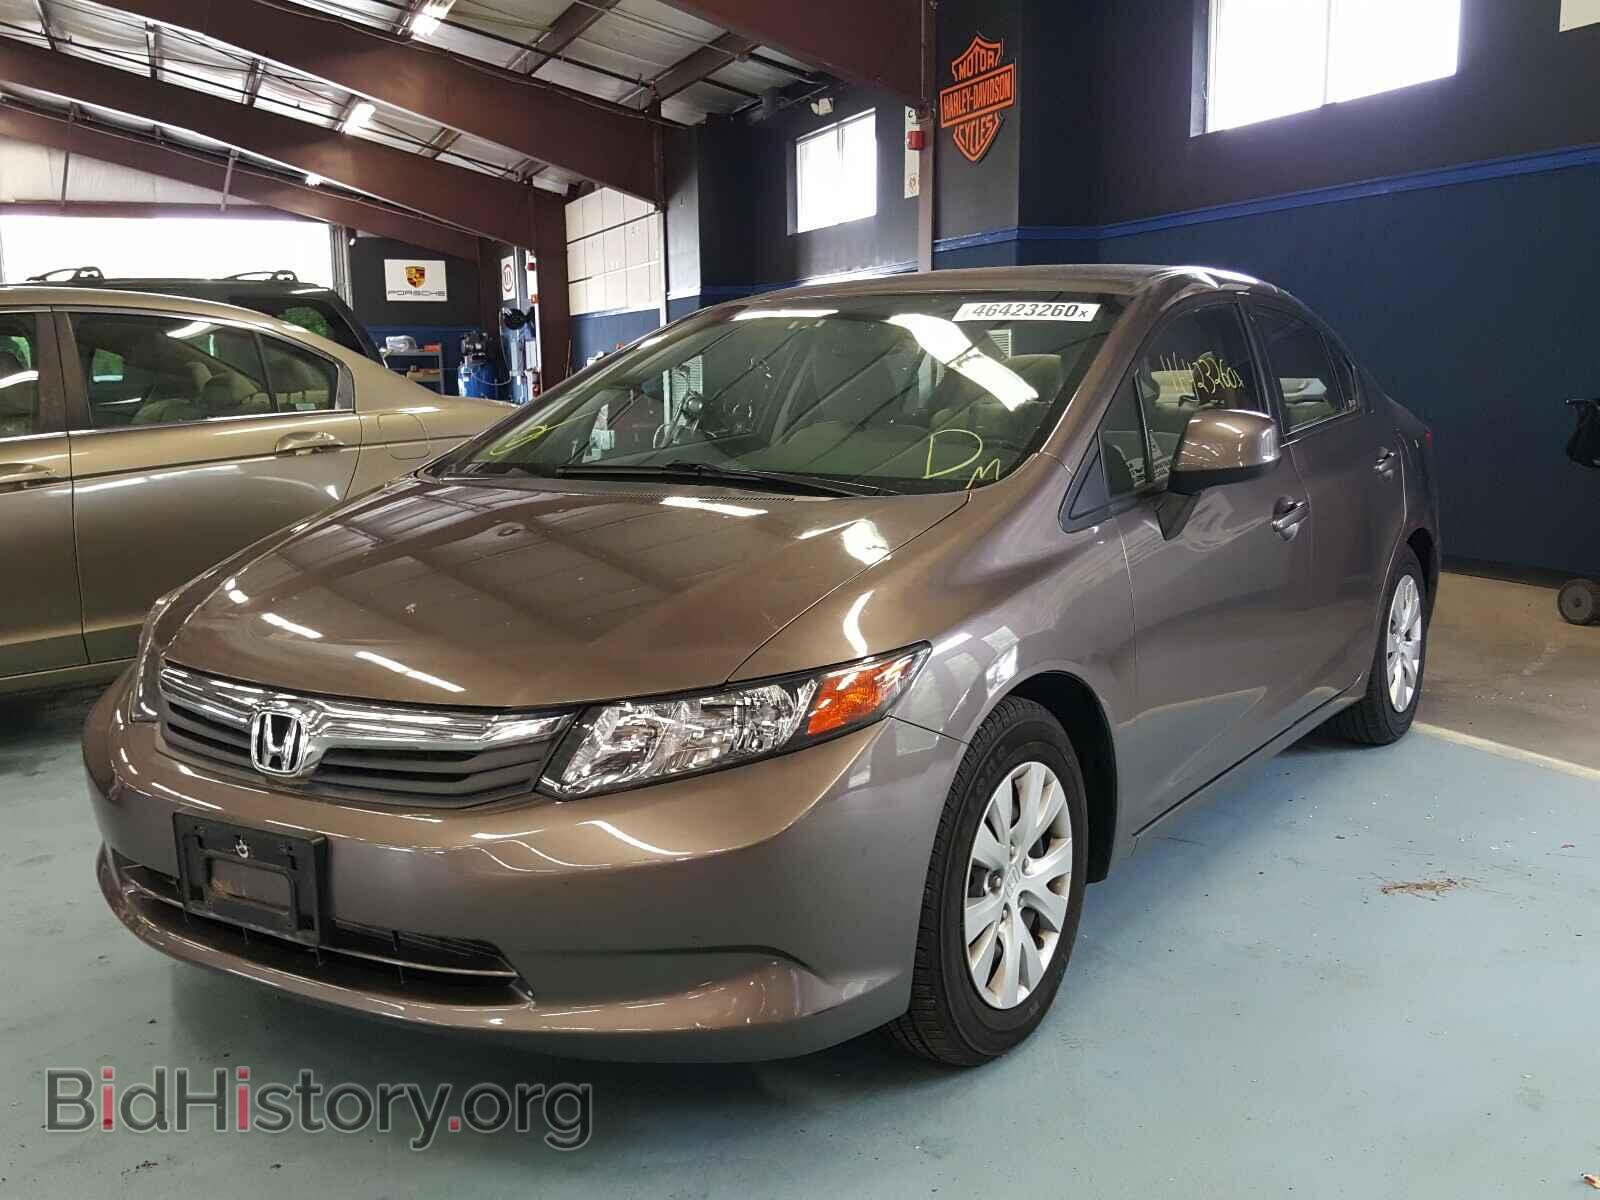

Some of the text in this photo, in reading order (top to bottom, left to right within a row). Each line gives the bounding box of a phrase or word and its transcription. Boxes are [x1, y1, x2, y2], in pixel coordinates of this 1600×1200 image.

[958, 49, 995, 80] MOTOR
[942, 71, 1012, 121] HARLEY-DAVIDSON
[958, 114, 994, 153] CYCLES
[387, 290, 446, 298] PORSCHE
